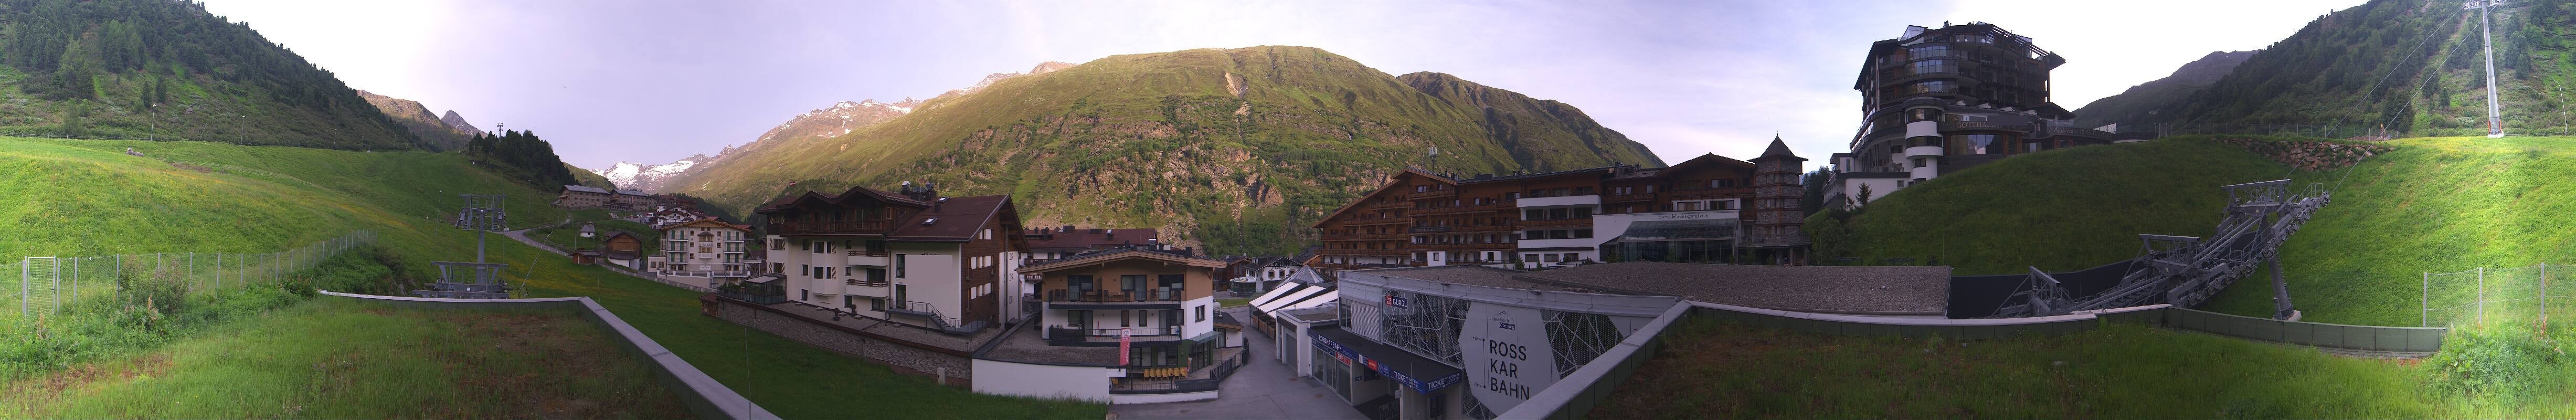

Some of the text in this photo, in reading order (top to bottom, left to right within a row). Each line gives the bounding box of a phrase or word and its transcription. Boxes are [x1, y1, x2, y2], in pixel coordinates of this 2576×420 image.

[1393, 298, 1407, 308] GURGL
[1319, 334, 1342, 352] ROSSKARBAHN
[1490, 340, 1526, 361] ROSS
[1393, 371, 1408, 384] TICKET
[1490, 358, 1518, 379] KAR
[1427, 377, 1448, 390] TICKET
[1491, 377, 1530, 400] BAHN
